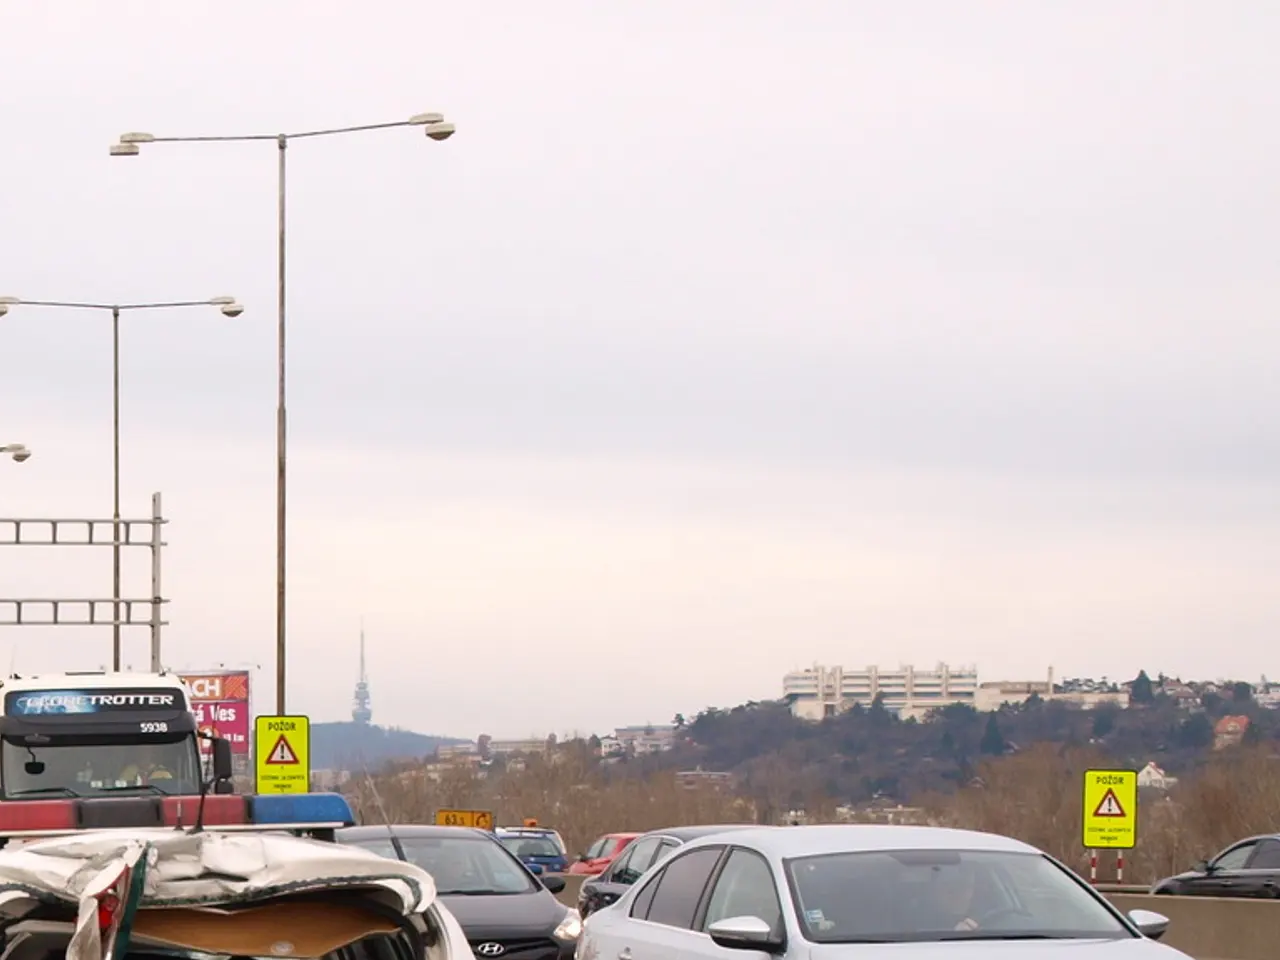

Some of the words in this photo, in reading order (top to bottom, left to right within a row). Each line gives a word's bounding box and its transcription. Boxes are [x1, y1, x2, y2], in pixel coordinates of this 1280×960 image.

[209, 704, 236, 722] Ves
[140, 722, 168, 734] 5938
[268, 721, 296, 731] POŽOR
[1096, 774, 1124, 785] POŽOR
